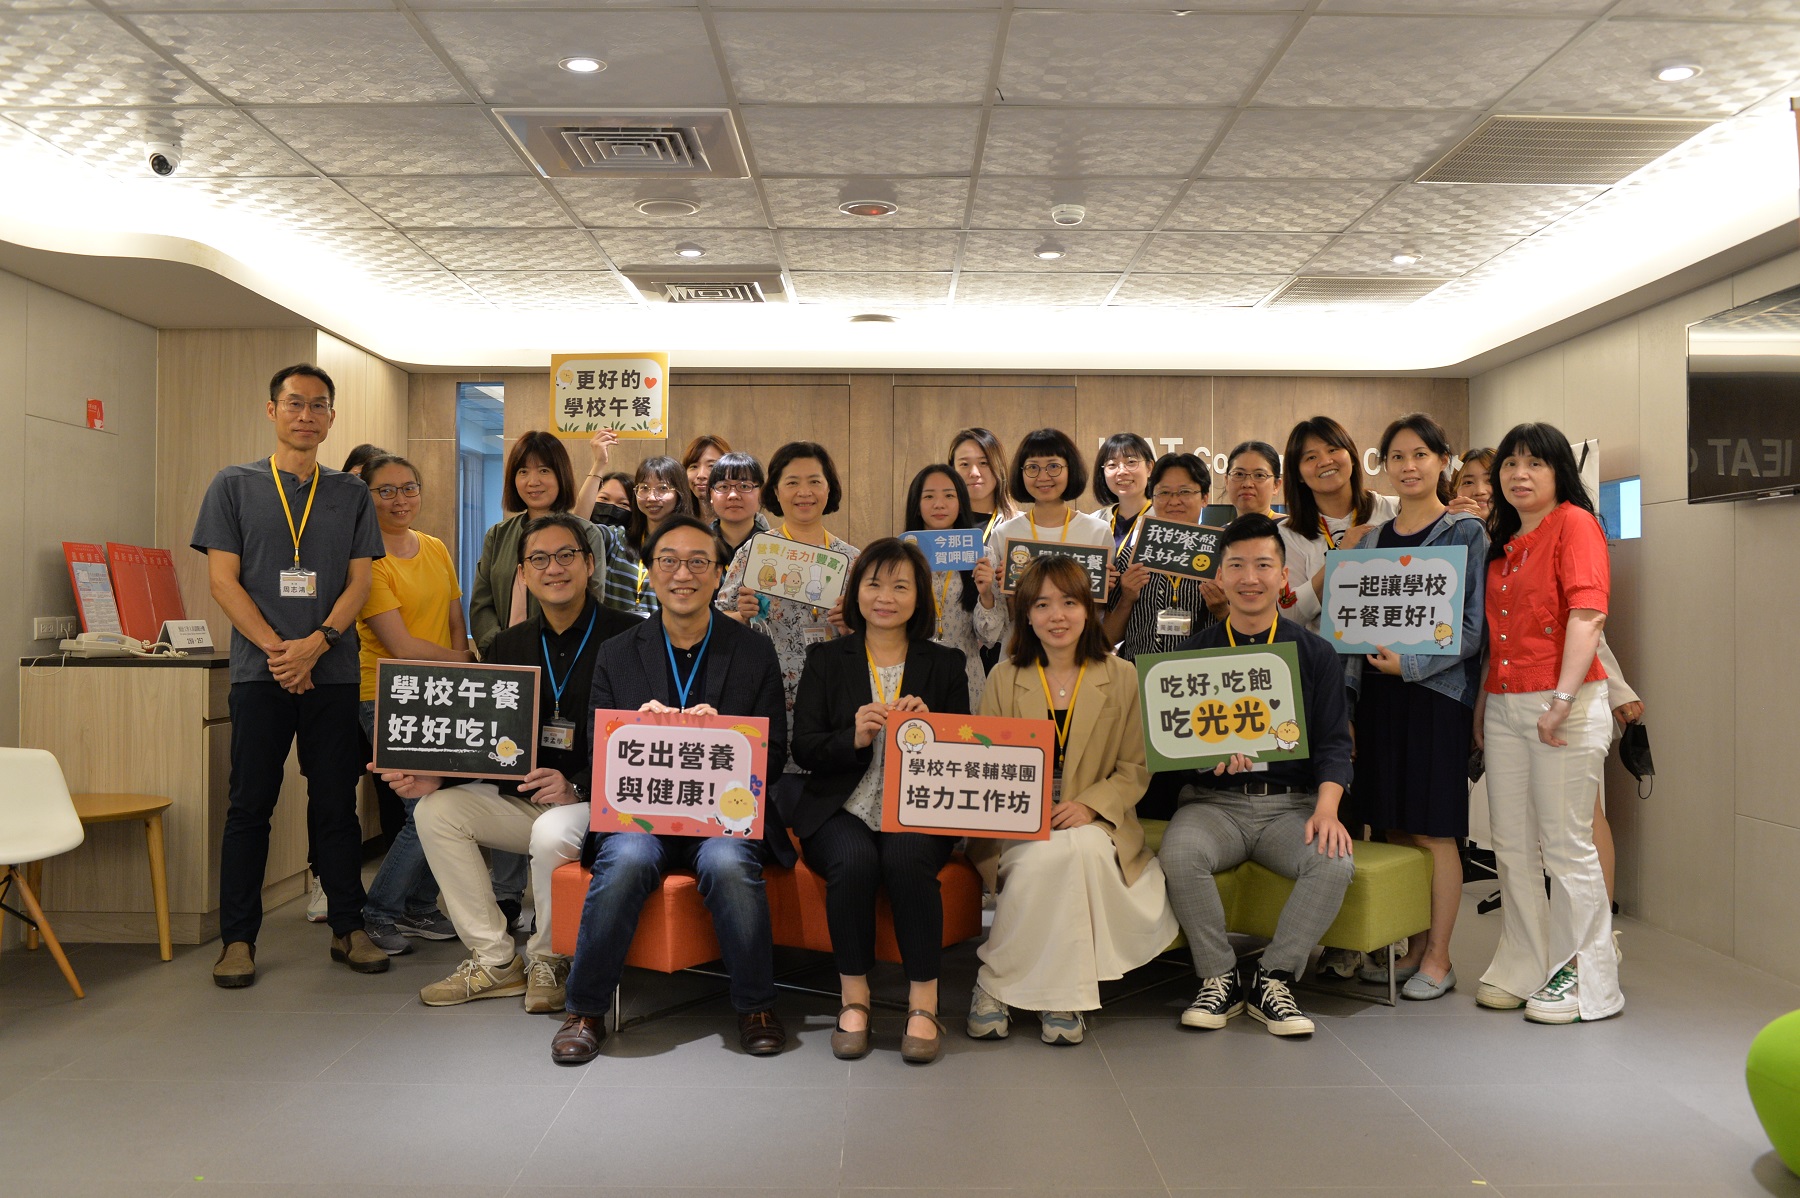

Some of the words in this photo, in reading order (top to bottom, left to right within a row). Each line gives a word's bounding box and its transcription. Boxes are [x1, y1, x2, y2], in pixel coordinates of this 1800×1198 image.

[576, 369, 641, 390] 更好的
[564, 396, 652, 418] 學校午餐
[934, 534, 974, 548] 今那日
[1146, 524, 1218, 554] 我的餐盤
[934, 550, 979, 565] 賀呷喔!
[1139, 544, 1191, 567] 真好吃
[1338, 573, 1447, 597] 一起讓學校
[1337, 605, 1436, 628] 午餐更好!
[390, 674, 520, 710] 學校午餐
[1160, 667, 1273, 699] 吃好,吃飽
[387, 713, 498, 747] 好好吃!
[1160, 700, 1266, 739] 吃光光
[618, 739, 735, 771] 吃出營養
[908, 758, 1036, 782] 學校午餐輔導團
[616, 776, 715, 807] 與健康!
[906, 784, 1031, 814] 培力工作坊
